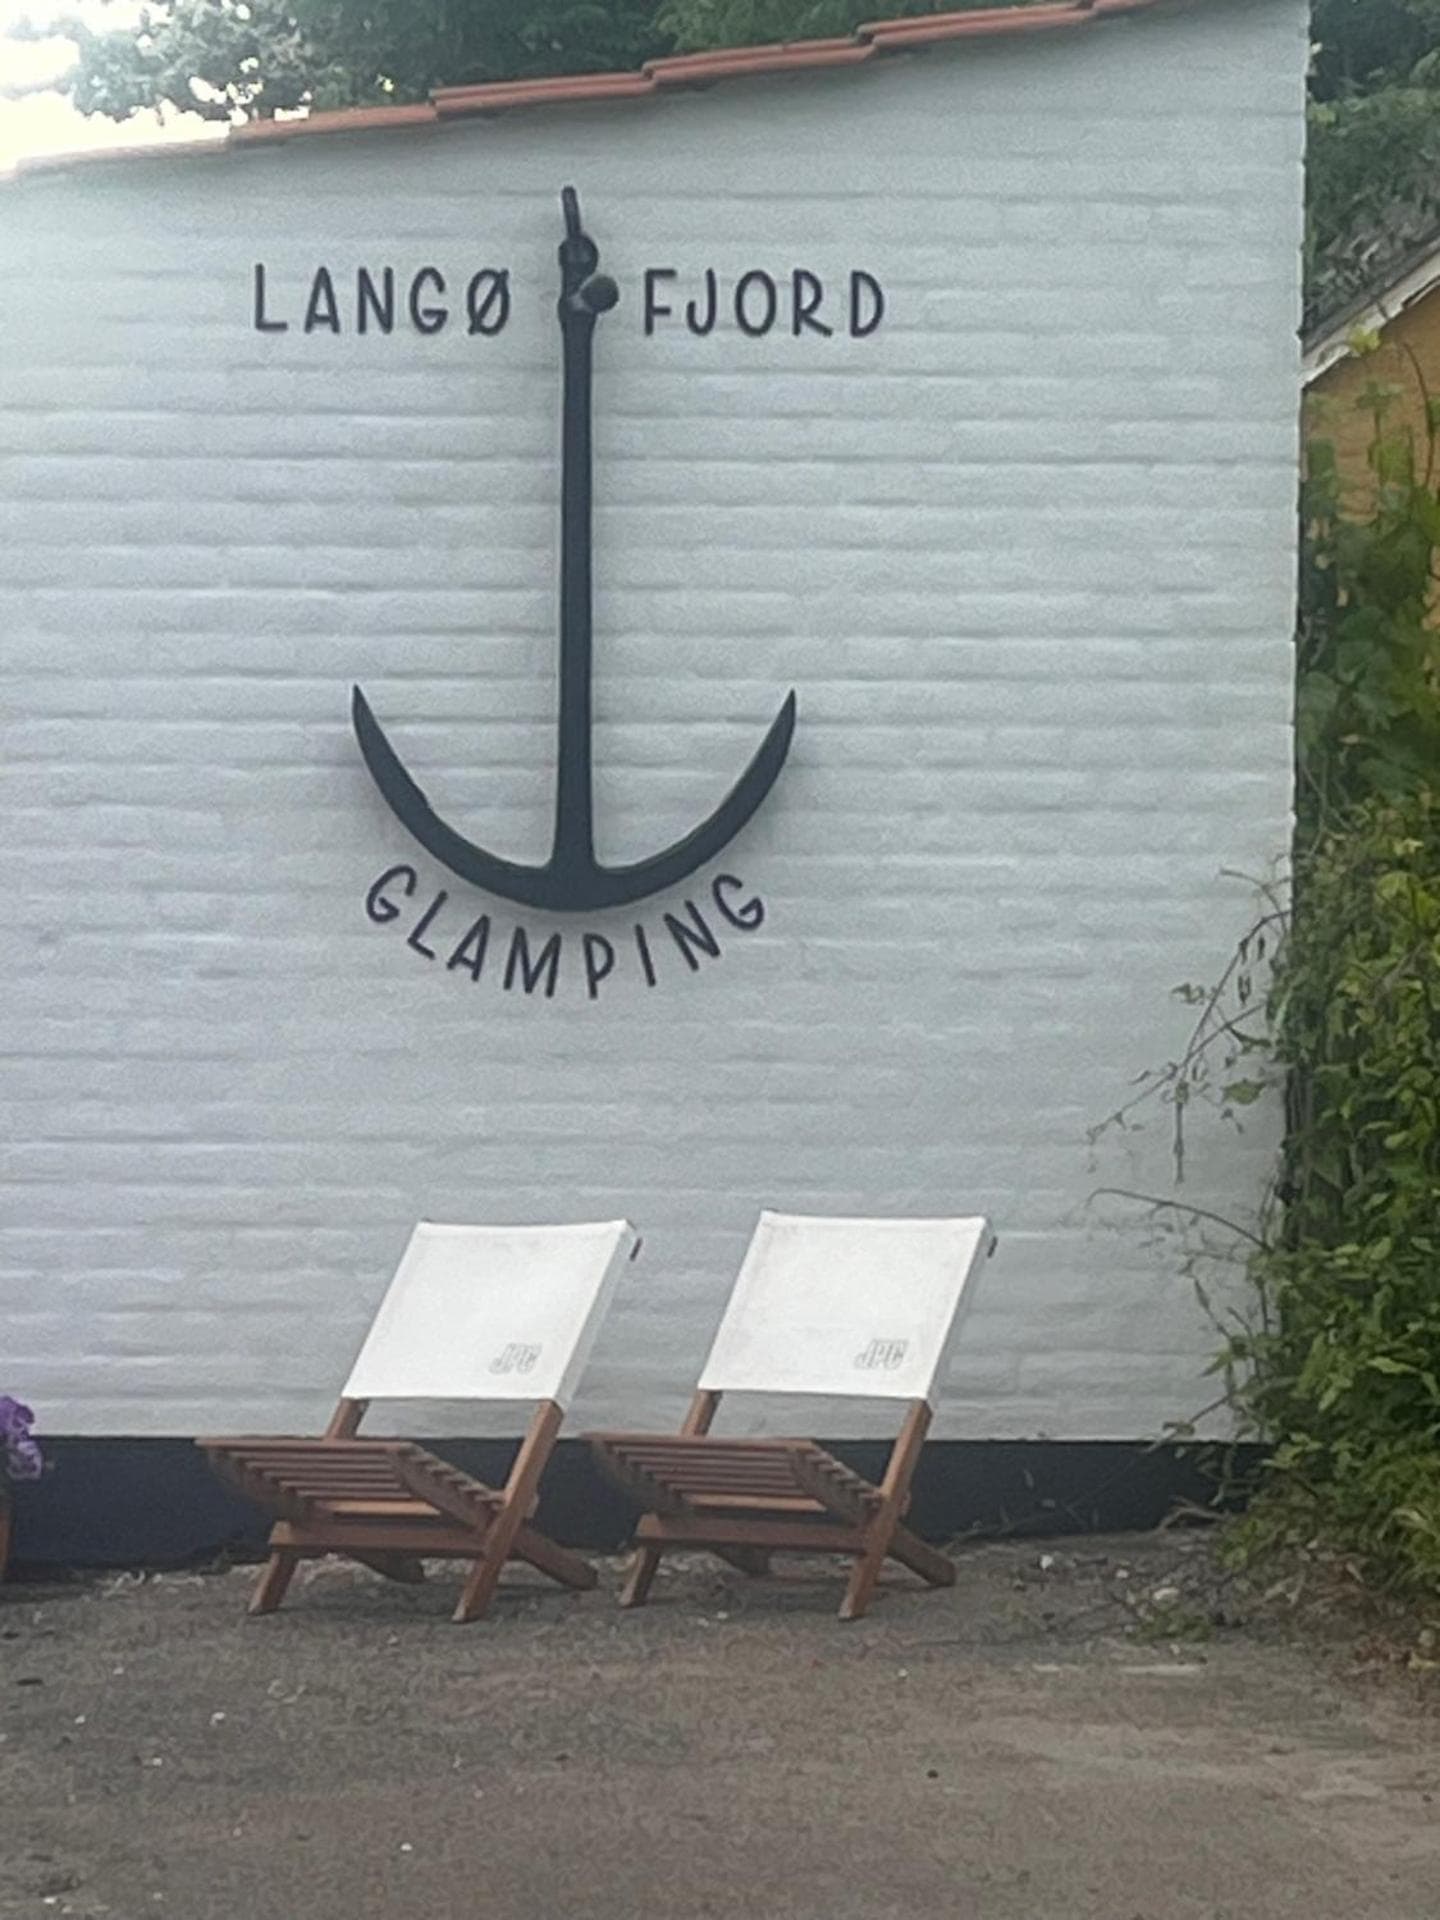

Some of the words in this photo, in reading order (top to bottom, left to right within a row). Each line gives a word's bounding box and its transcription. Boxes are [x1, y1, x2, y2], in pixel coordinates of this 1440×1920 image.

[253, 262, 512, 337] LANGØ
[644, 267, 885, 338] FJORD
[365, 864, 766, 999] GLAMPING
